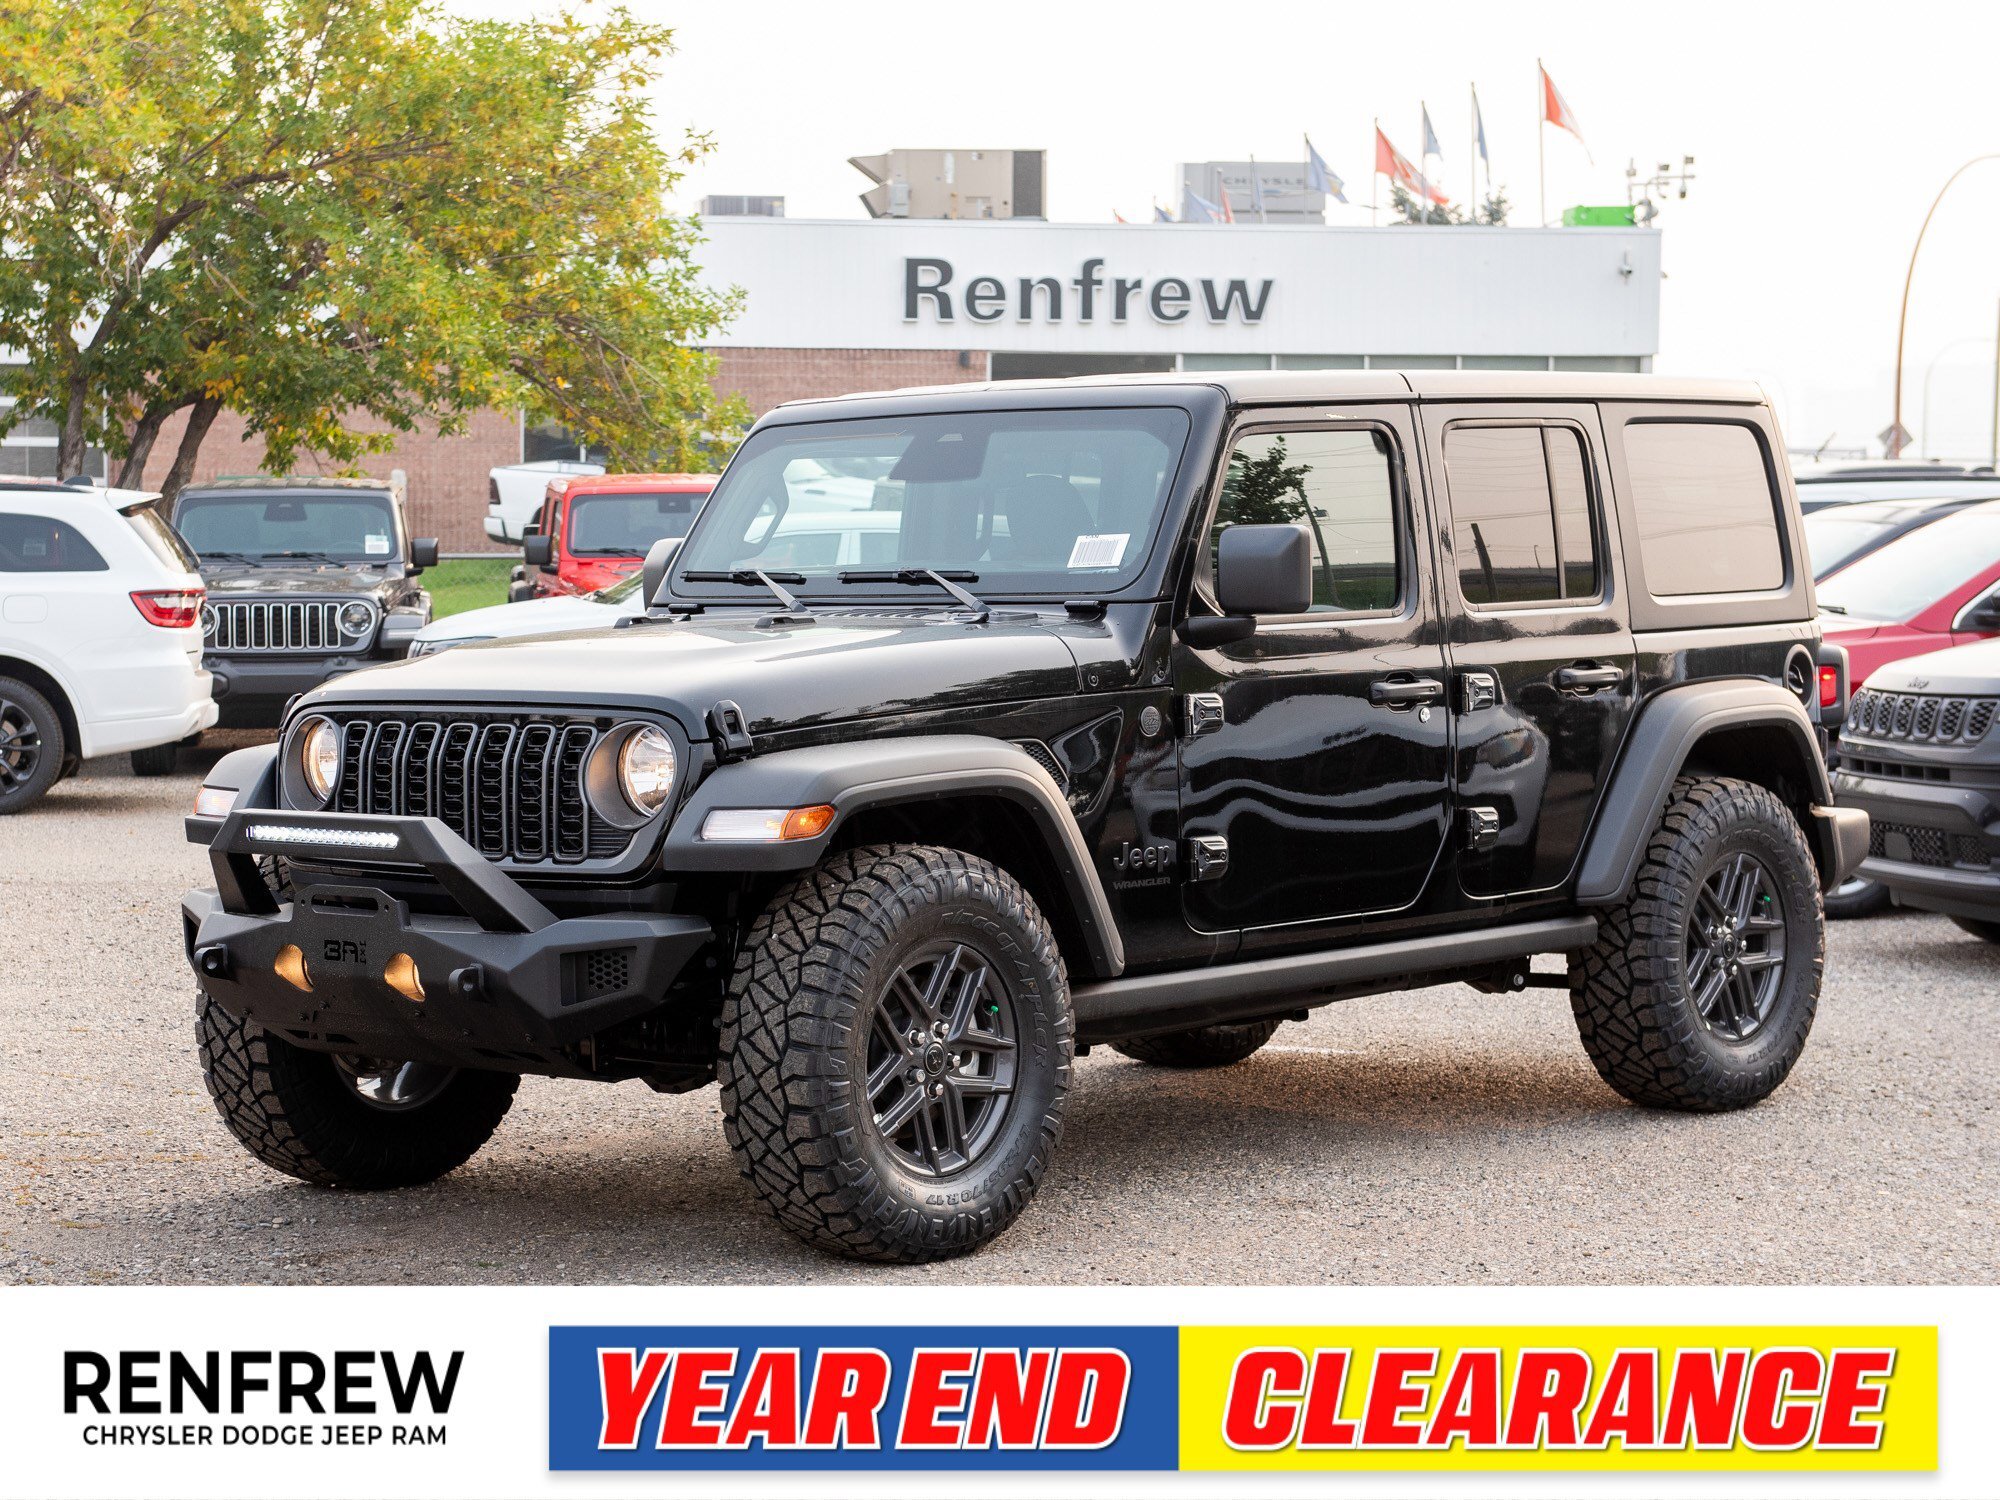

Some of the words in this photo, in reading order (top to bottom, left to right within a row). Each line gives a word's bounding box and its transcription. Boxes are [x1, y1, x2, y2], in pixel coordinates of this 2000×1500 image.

[902, 257, 1274, 324] Renfrew
[1113, 842, 1171, 872] Jeep
[1112, 876, 1171, 890] WRANGLER
